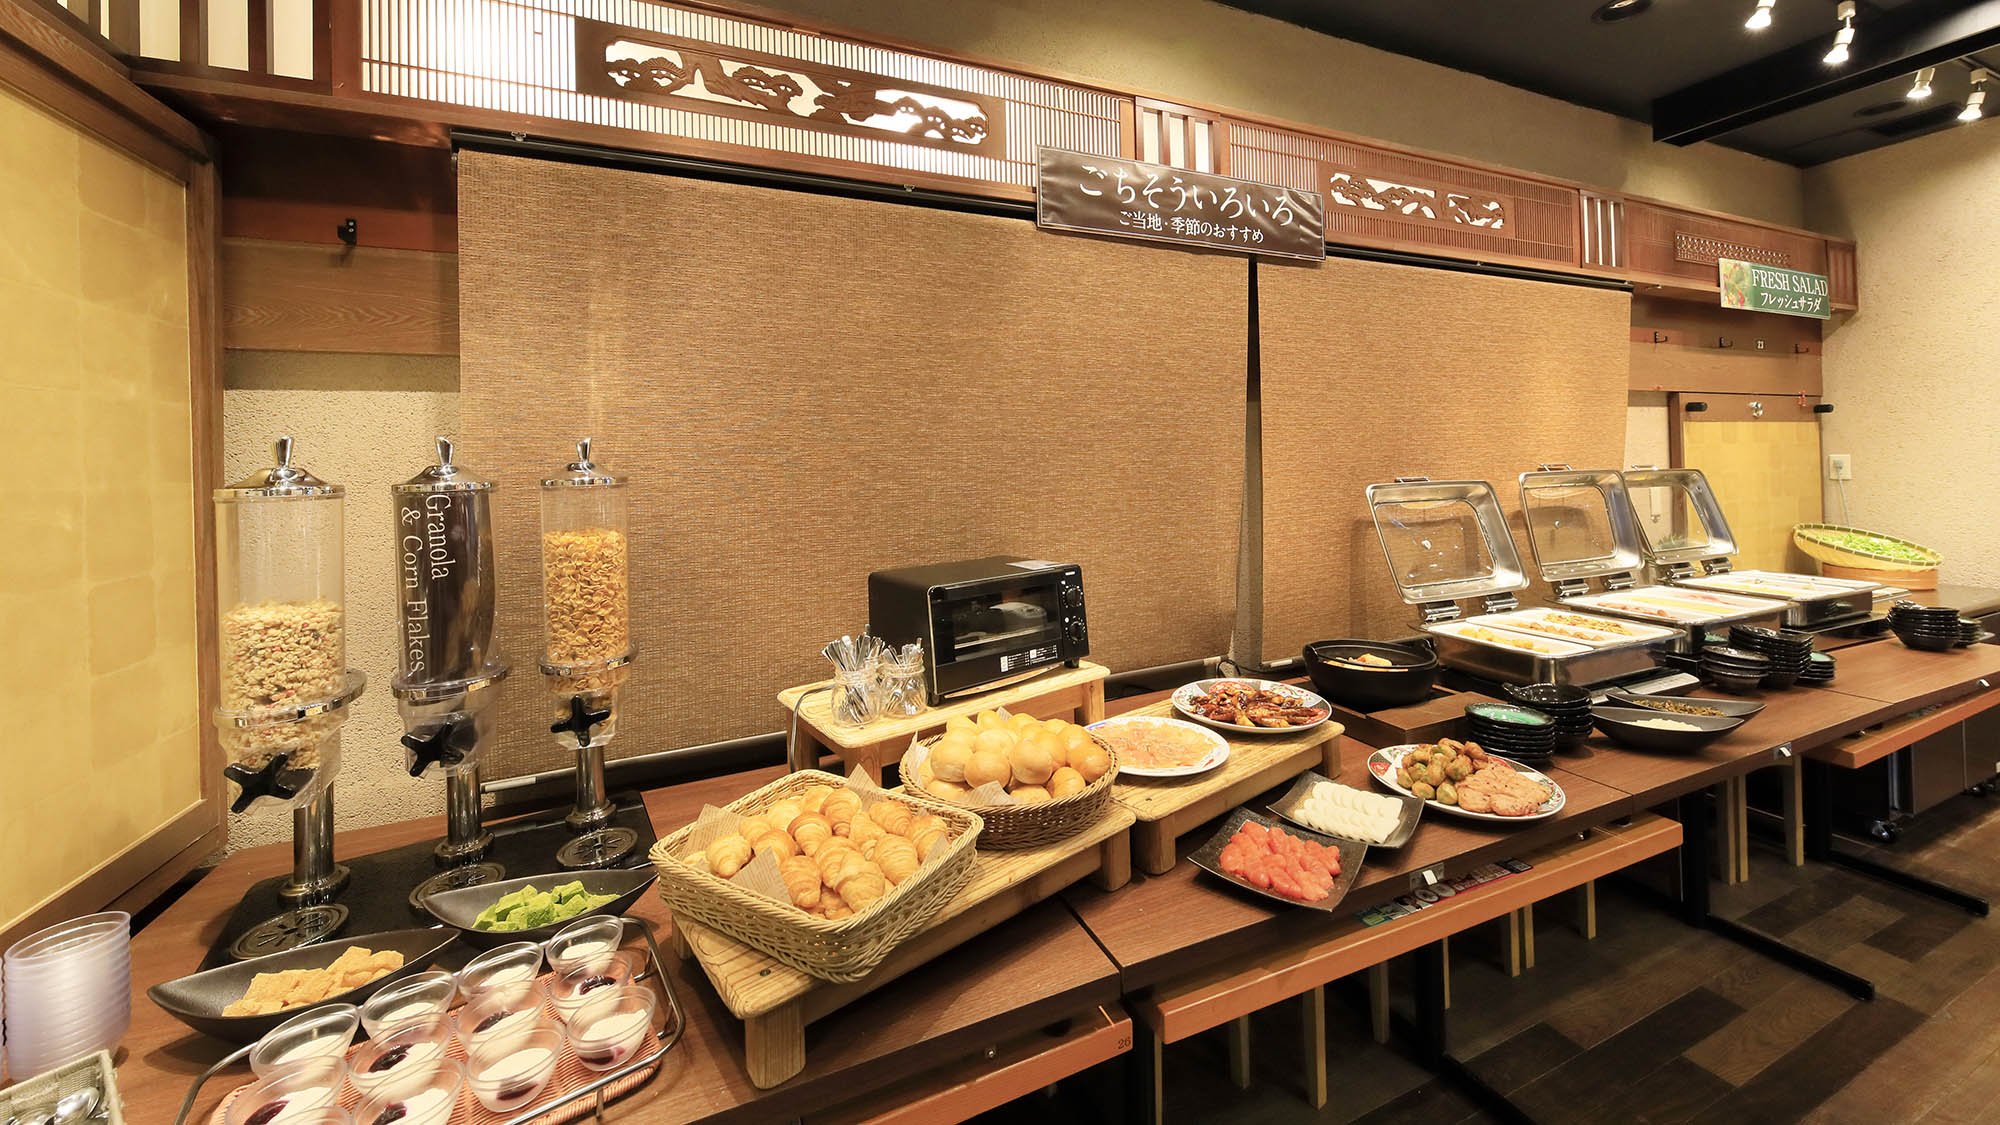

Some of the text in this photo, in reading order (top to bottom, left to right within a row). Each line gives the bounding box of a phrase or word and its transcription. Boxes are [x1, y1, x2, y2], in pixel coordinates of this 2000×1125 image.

[1079, 165, 1294, 226] ごちそういろいろ
[1119, 210, 1265, 244] ご当地・季節のおすすめ
[1752, 268, 1828, 297] FRESH SALAD
[1760, 292, 1822, 313] フレッシュサラダ
[425, 494, 456, 580] Granola
[401, 507, 431, 673] & Corn Flakes
[1117, 1036, 1131, 1050] 26
